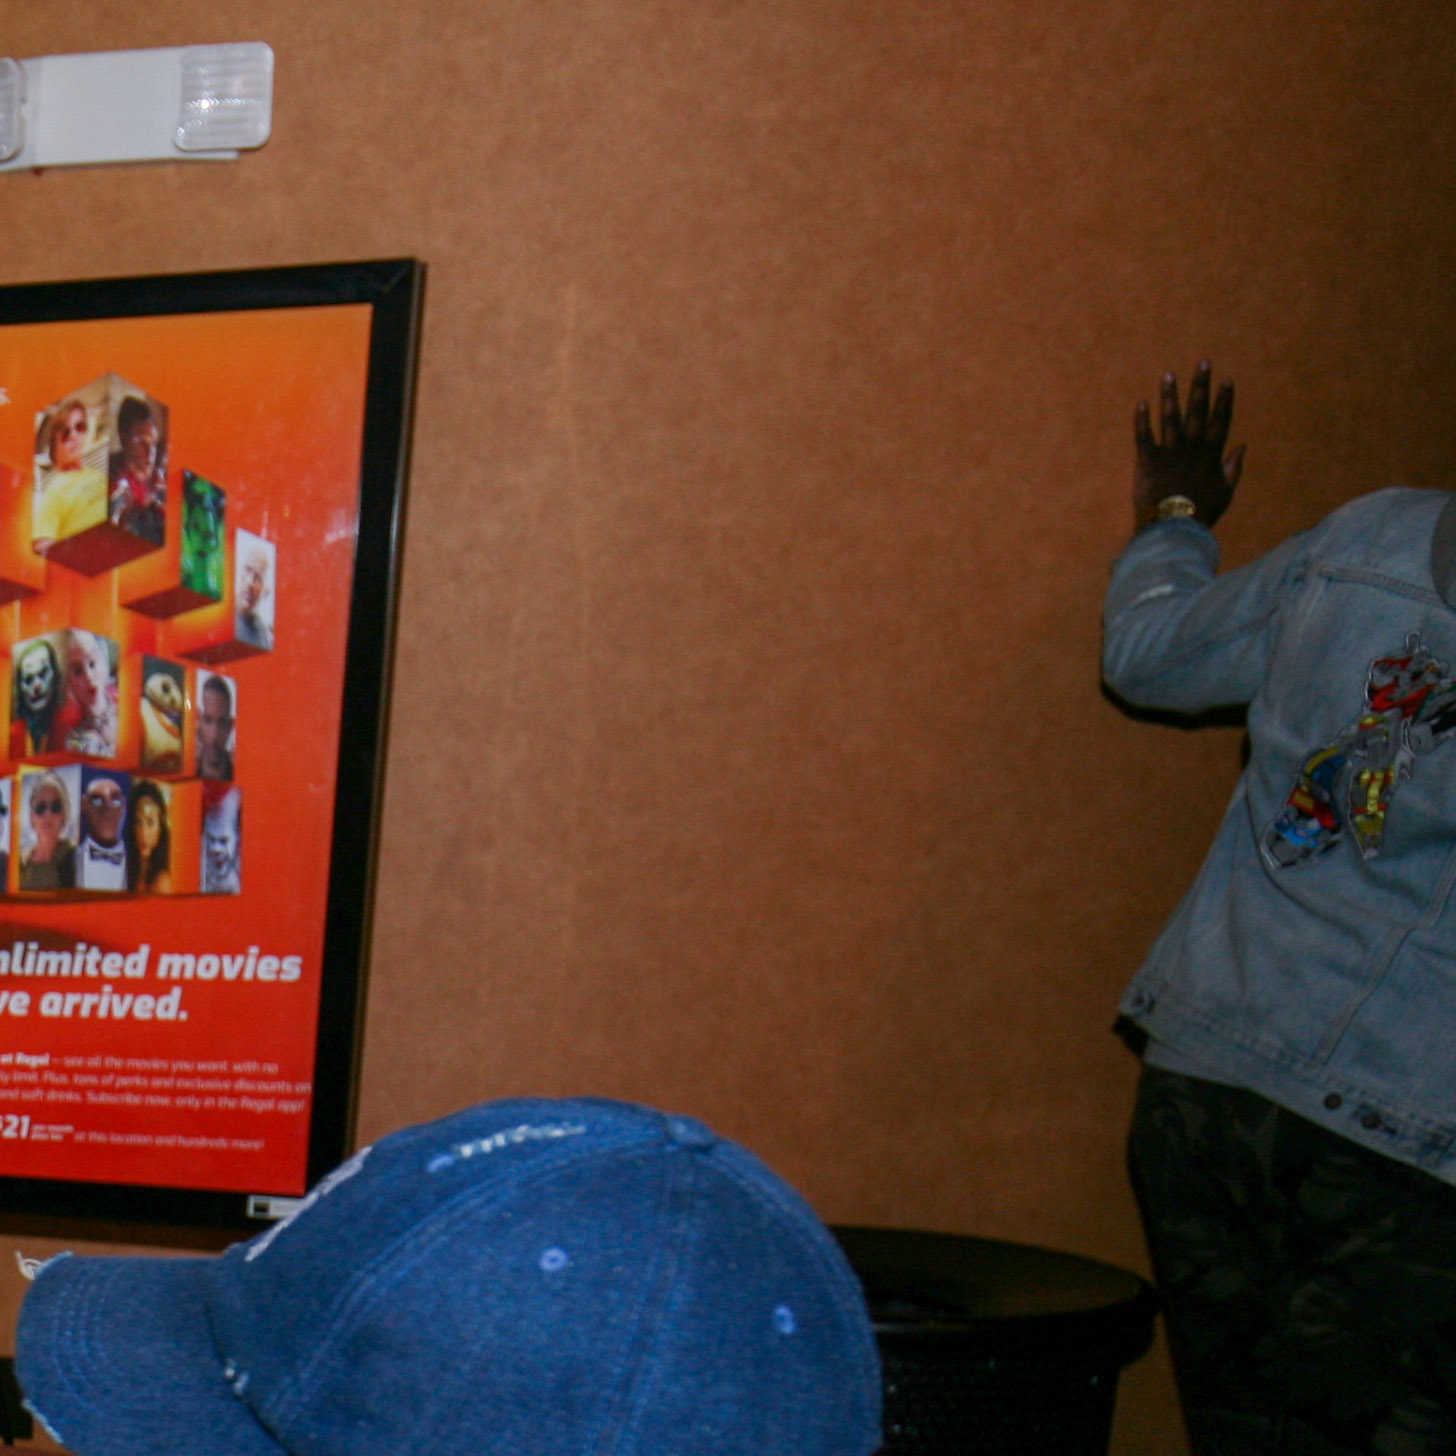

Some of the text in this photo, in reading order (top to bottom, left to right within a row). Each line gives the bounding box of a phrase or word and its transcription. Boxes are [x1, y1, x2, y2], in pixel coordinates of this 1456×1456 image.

[157, 945, 303, 982] movies
[39, 986, 188, 1021] arrived.
[15, 1052, 51, 1068] Regal
